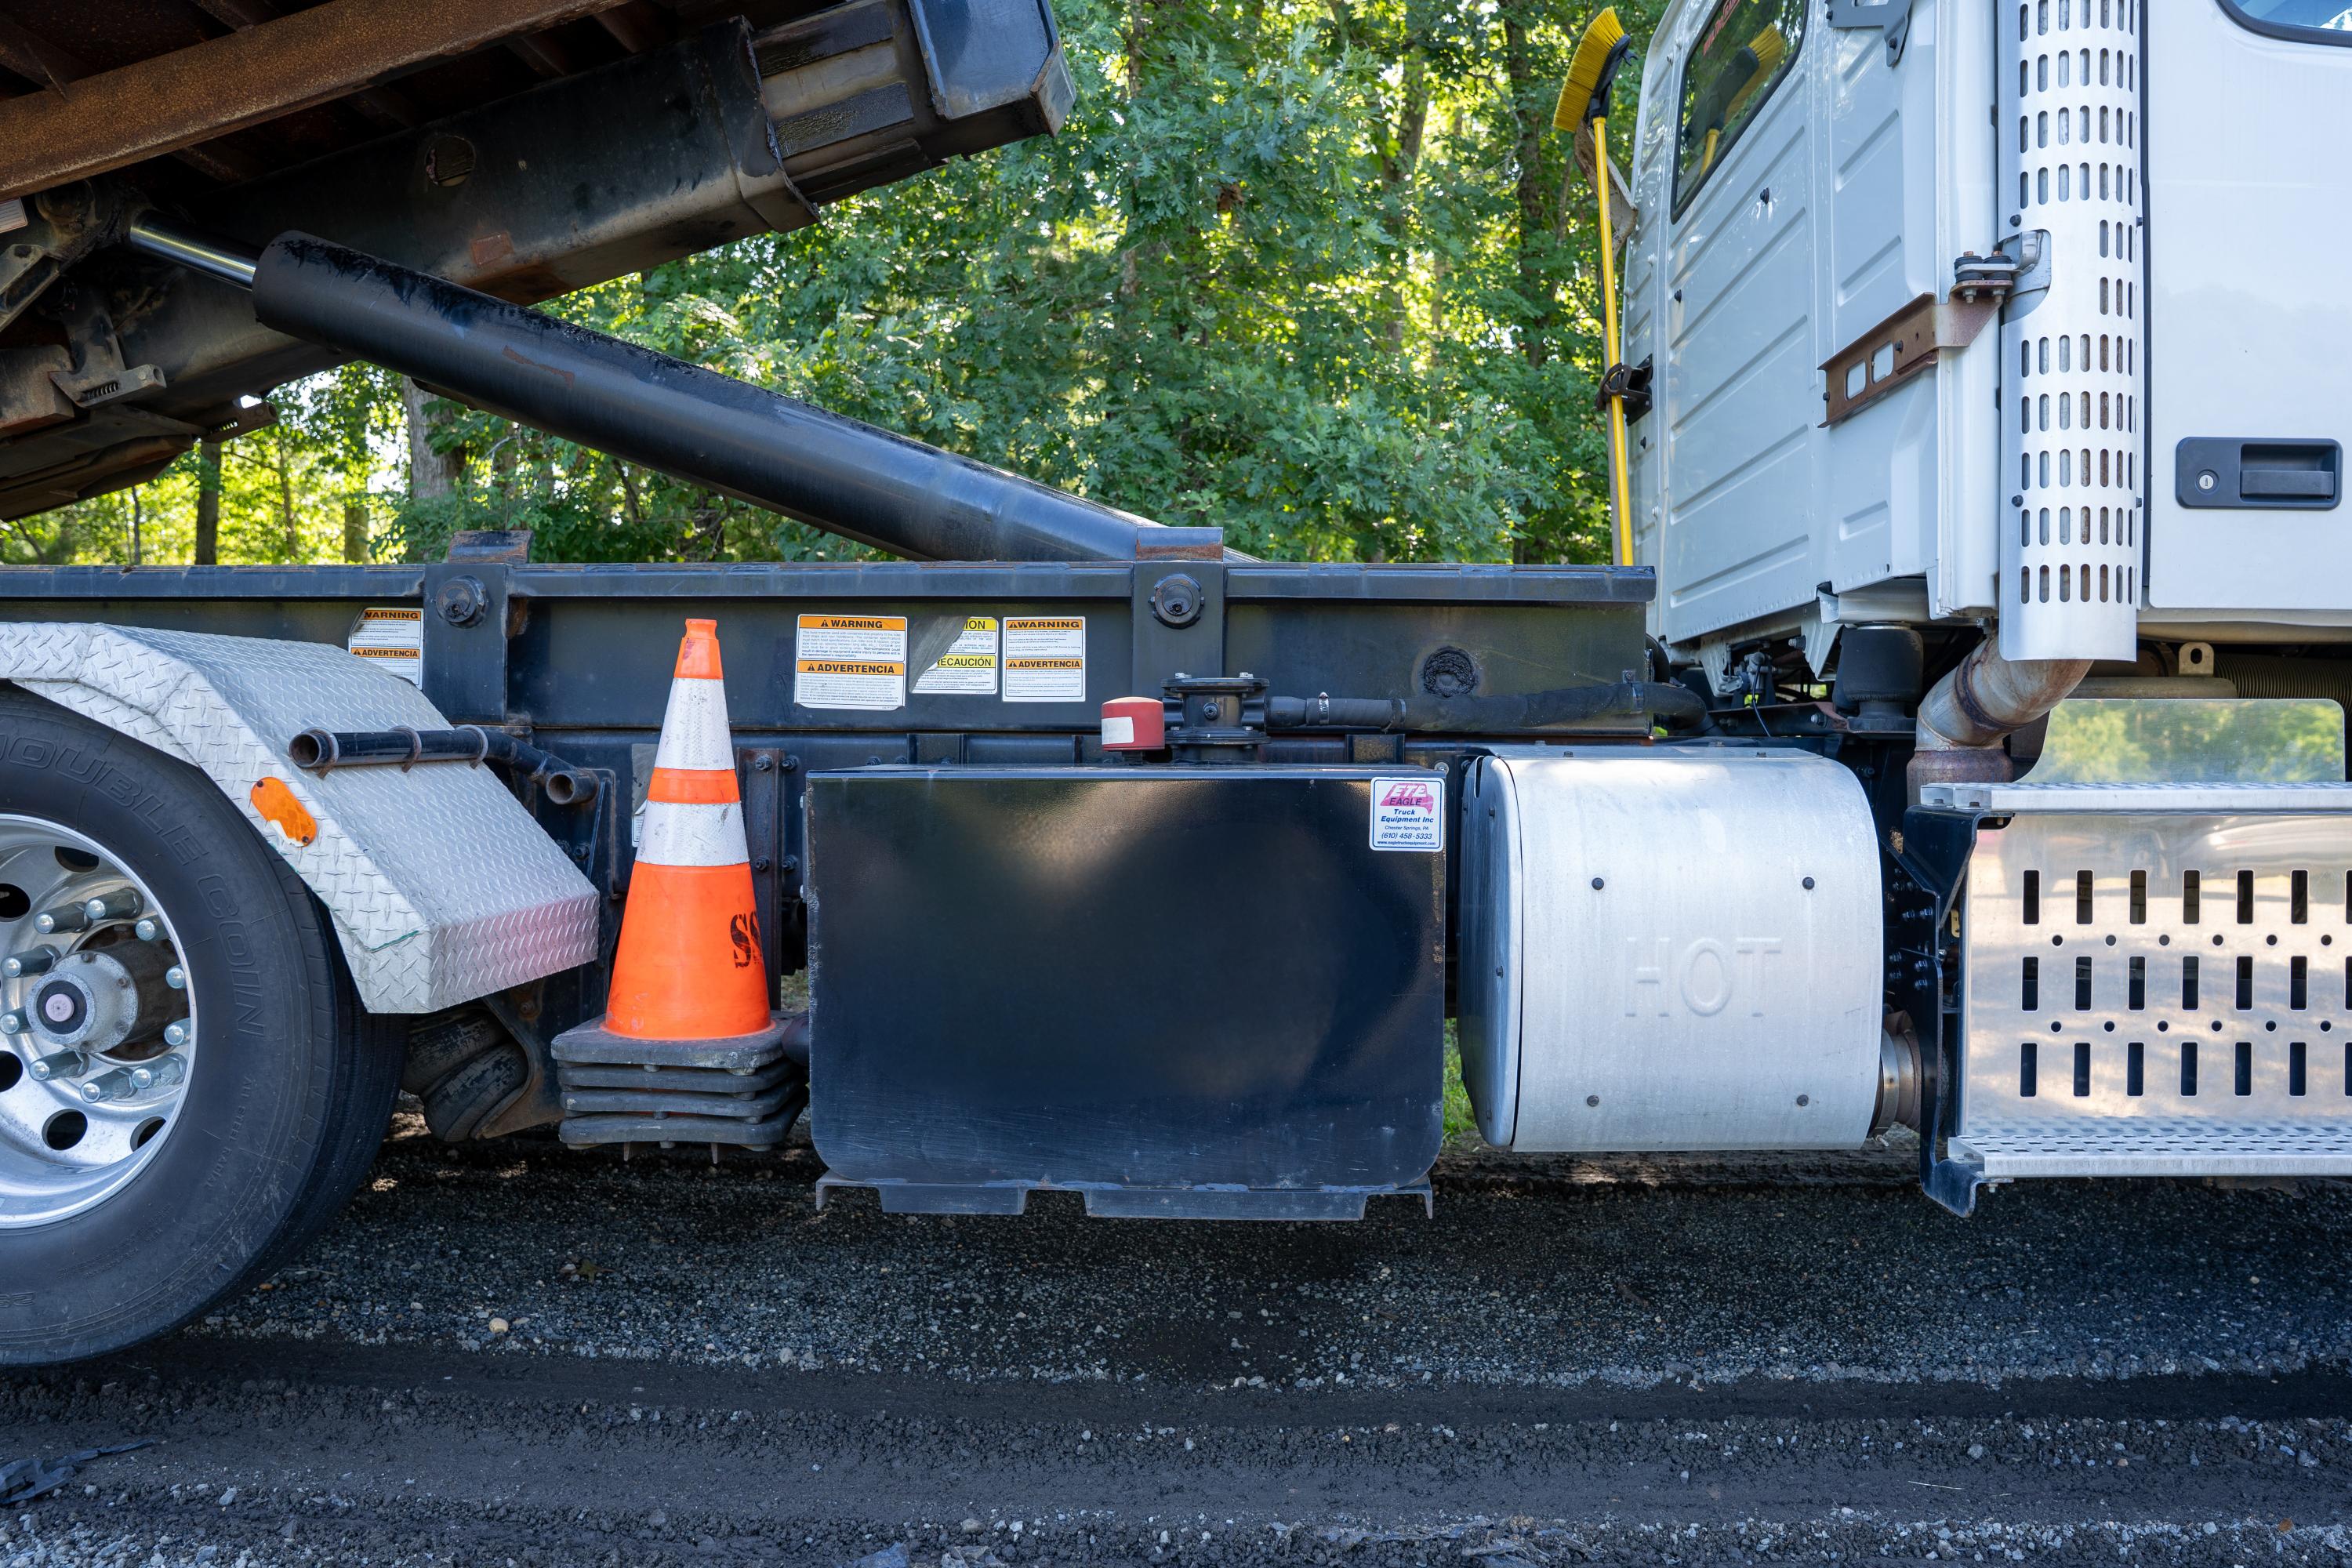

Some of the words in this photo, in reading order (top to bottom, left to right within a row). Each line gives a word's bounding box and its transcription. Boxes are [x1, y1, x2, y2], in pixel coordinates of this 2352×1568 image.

[830, 619, 883, 629] WARNING
[937, 656, 991, 666] ECAUCIÓN
[817, 663, 895, 673] ADVERTENCIA
[0, 734, 209, 866] OUBLE
[1389, 797, 1422, 806] EAGLE
[198, 873, 265, 1036] COIN
[1624, 937, 1782, 1018] HOT
